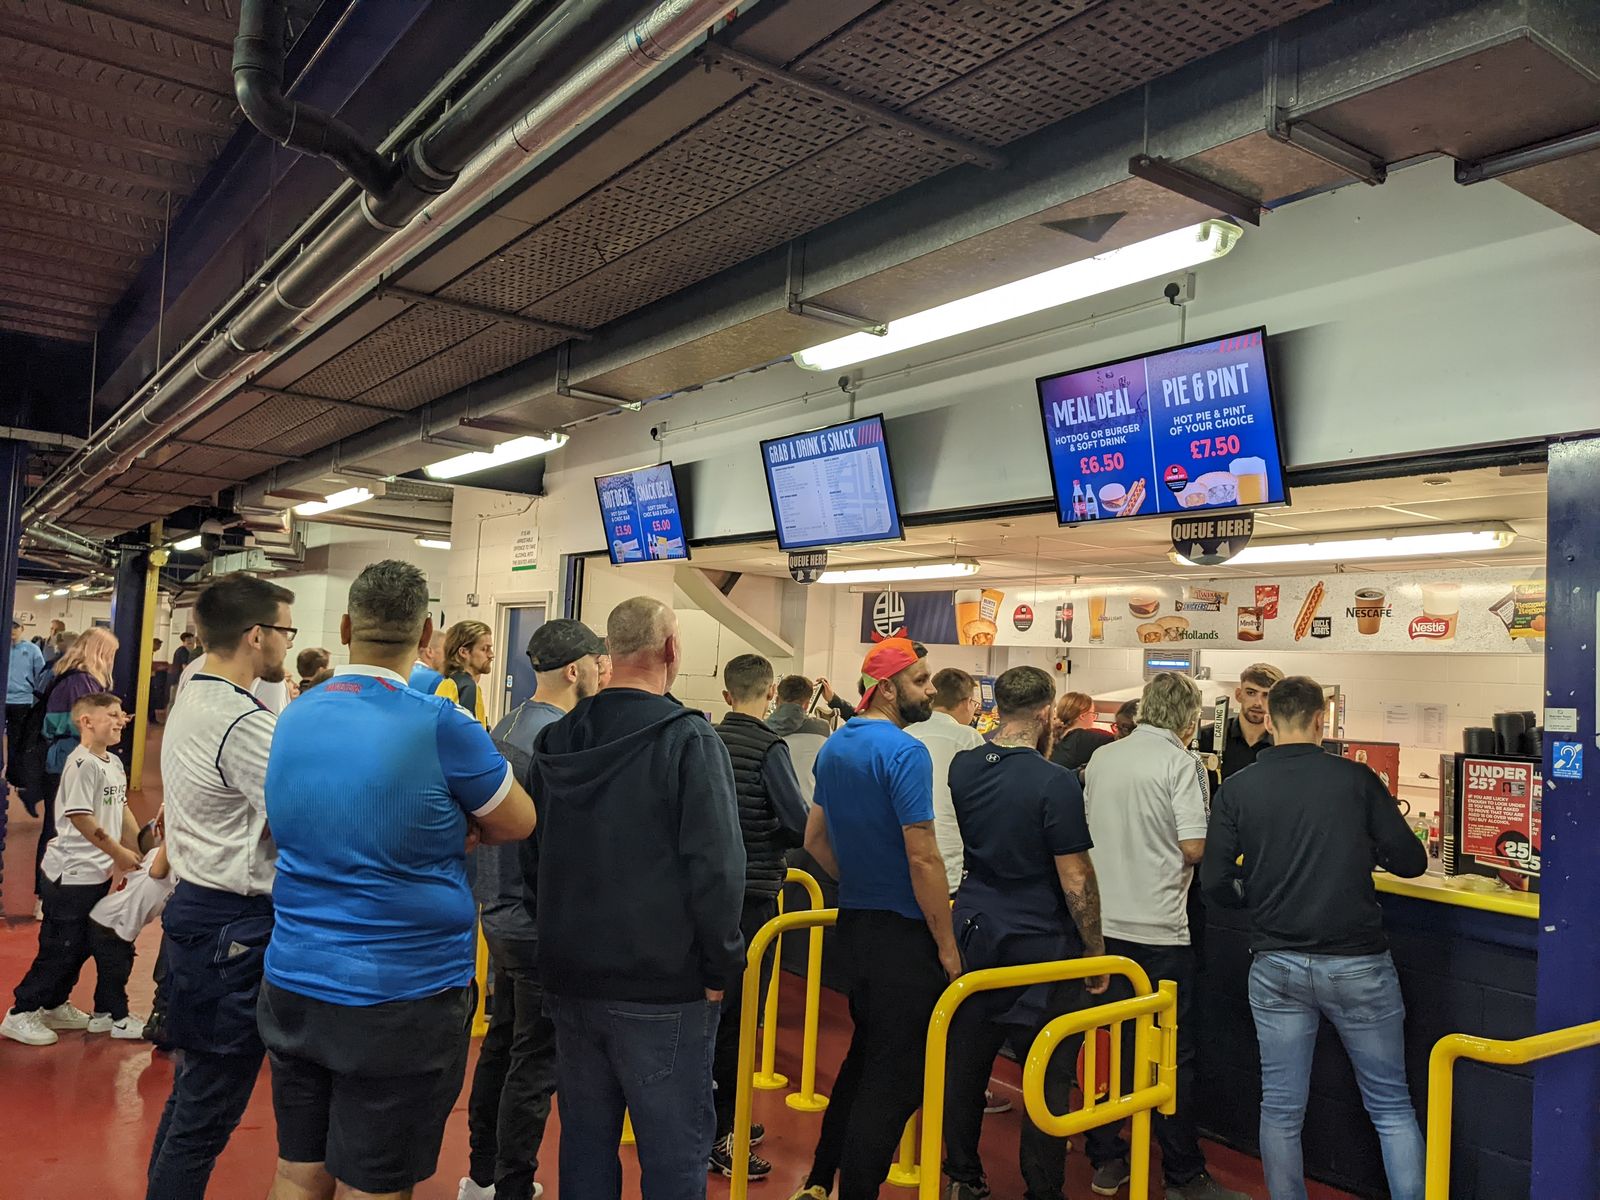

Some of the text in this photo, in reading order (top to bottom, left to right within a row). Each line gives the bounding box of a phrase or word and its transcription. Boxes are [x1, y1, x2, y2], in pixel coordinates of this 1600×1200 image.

[1162, 363, 1249, 408] PIE & PINT
[1053, 387, 1136, 428] MEAL DEAL
[1173, 405, 1246, 426] HOT PIE & PINT
[1055, 423, 1140, 446] HOTDOG OR BURGER
[1170, 414, 1254, 436] OF YOUR CHOICE
[769, 428, 857, 464] GRAB A DRINK & SNACK
[1069, 435, 1127, 452] & SOFT DRINK
[1190, 435, 1240, 459] £7.50
[1079, 452, 1124, 475] £6.50
[603, 487, 632, 509] HOT DEAL
[637, 480, 673, 502] SNACK DEAL
[653, 519, 671, 532] £5.00
[1173, 519, 1251, 541] QUEUE HERE
[790, 554, 827, 568] QUEUE HERE
[1181, 630, 1219, 640] Holland's
[1215, 710, 1223, 738] CARLING
[1468, 765, 1527, 780] UNDER
[1468, 778, 1497, 790] 25?
[1505, 841, 1529, 858] 25
